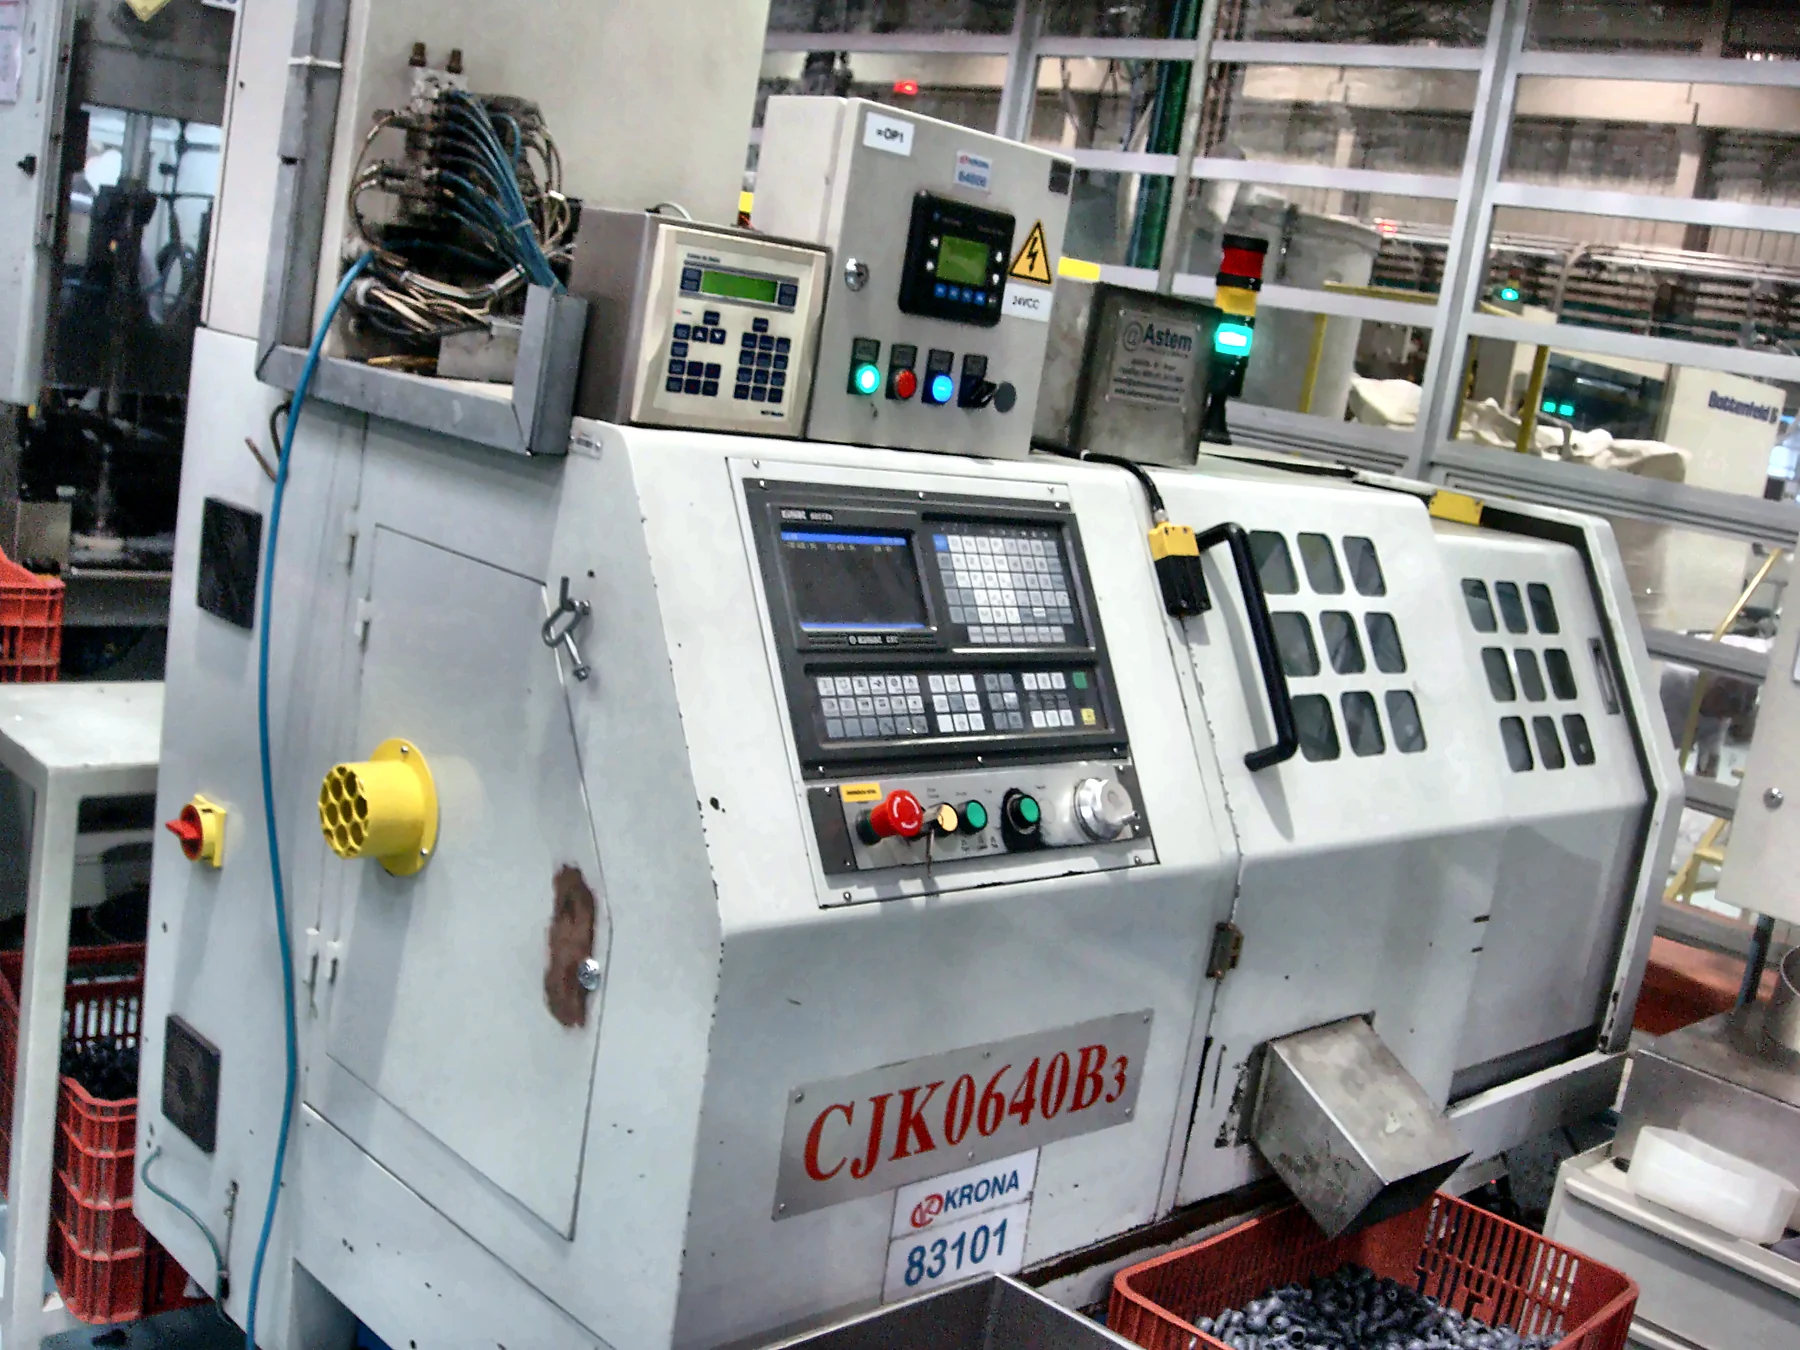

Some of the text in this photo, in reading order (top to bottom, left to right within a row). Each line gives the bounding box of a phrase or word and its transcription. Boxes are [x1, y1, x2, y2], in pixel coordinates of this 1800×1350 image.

[803, 1044, 1129, 1182] CJK0640B3
[943, 1169, 1020, 1214] KRONA
[904, 1218, 1008, 1287] 83101
